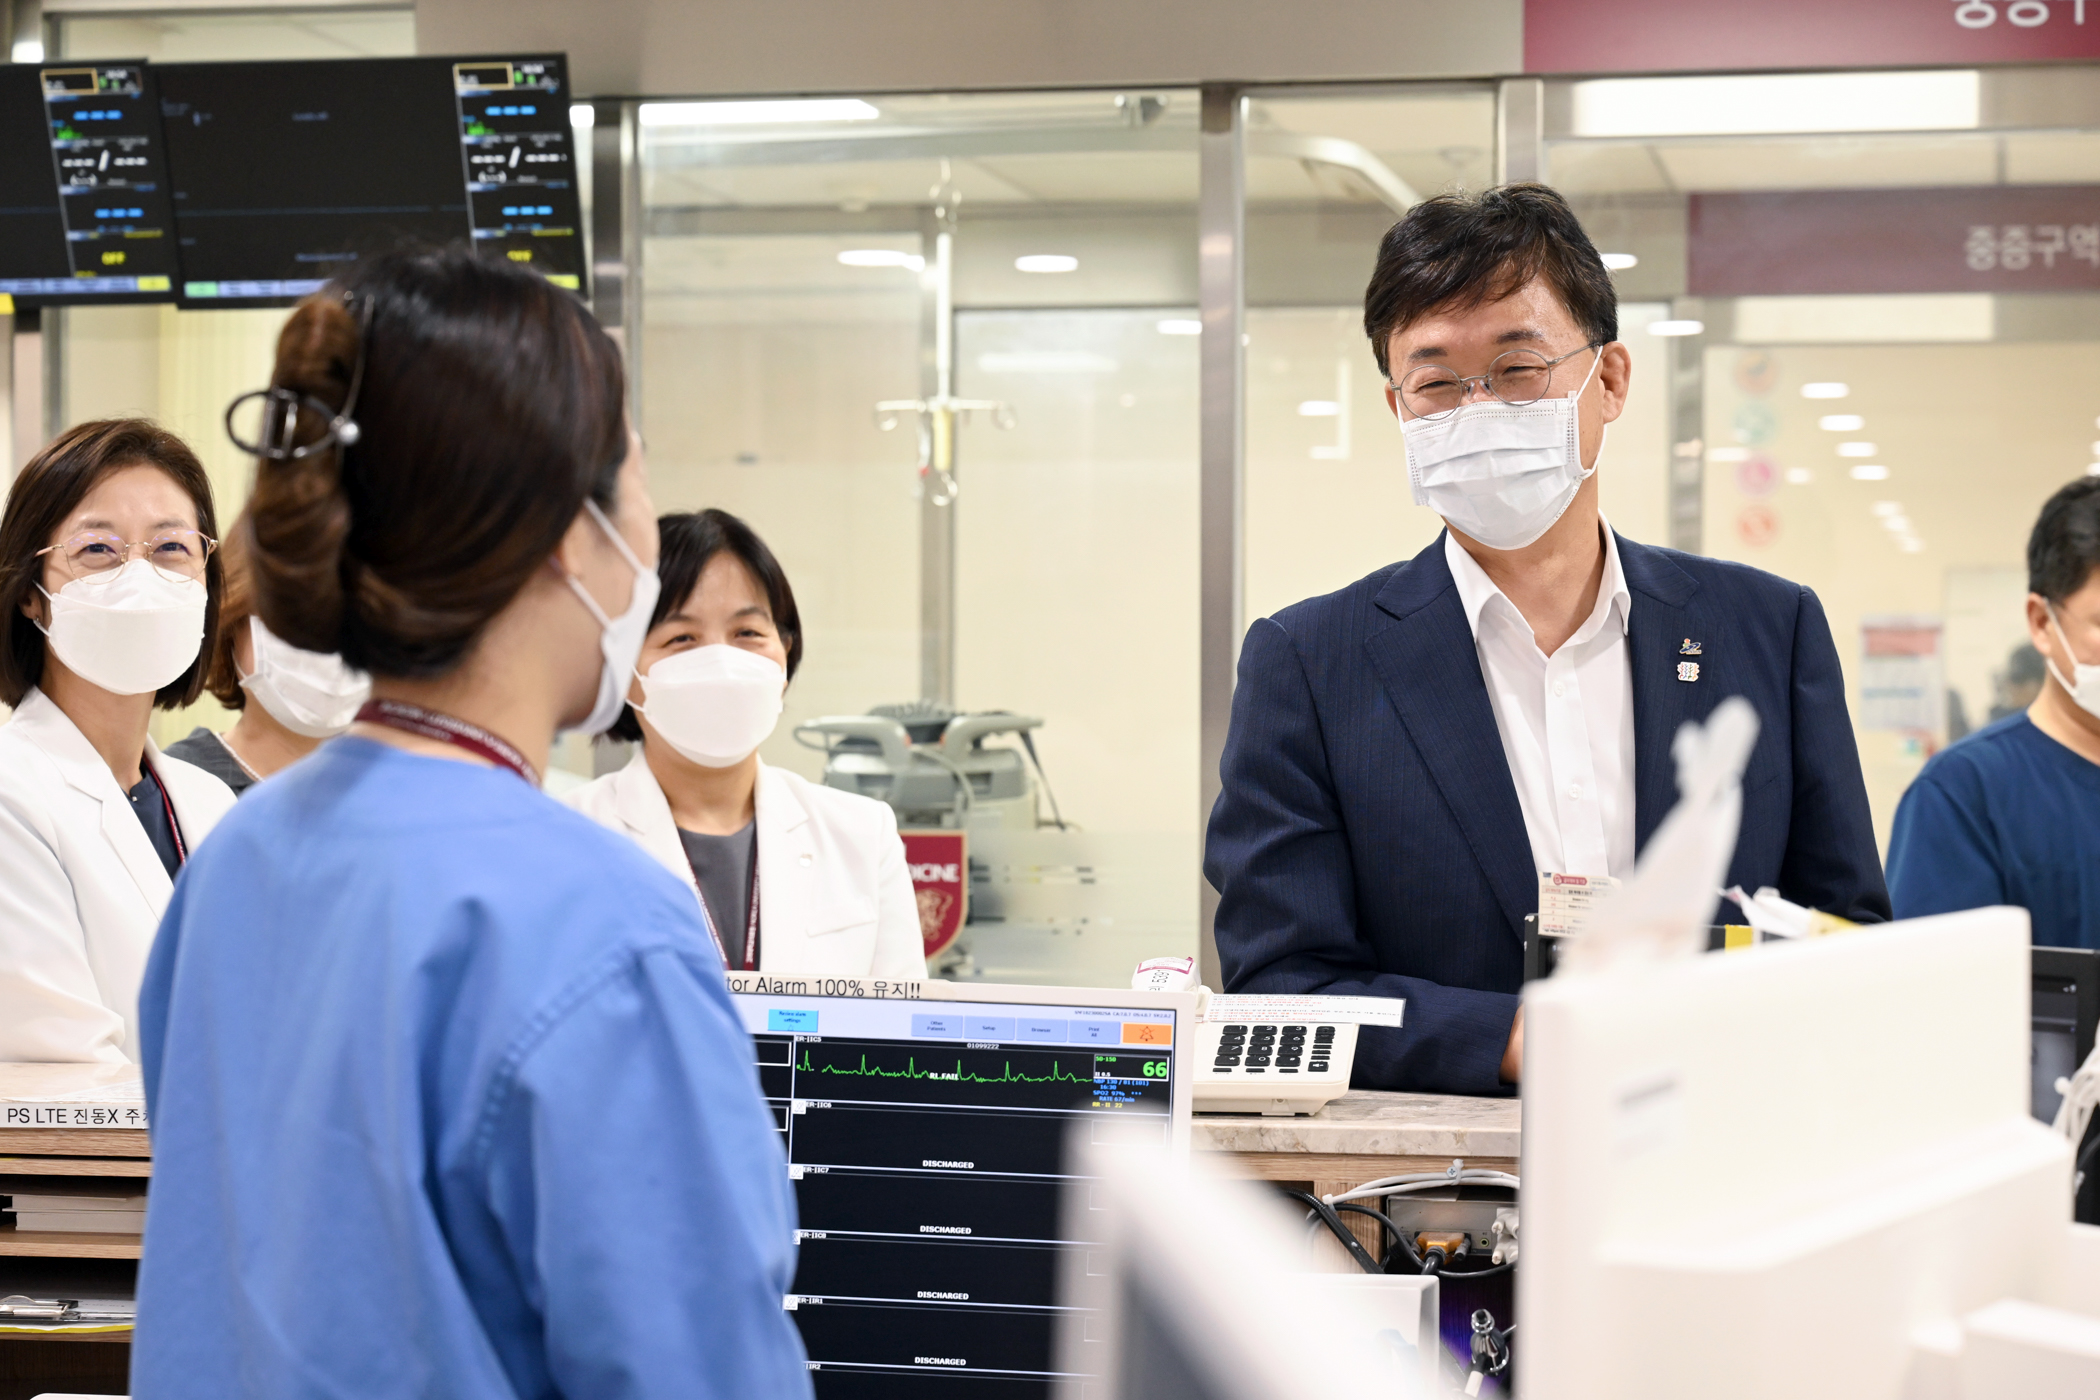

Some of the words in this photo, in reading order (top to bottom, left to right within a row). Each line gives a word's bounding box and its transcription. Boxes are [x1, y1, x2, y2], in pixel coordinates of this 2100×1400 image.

[755, 976, 807, 995] Alarm
[815, 978, 865, 997] 100%
[872, 980, 921, 998] 유지!!
[1142, 1060, 1168, 1078] 66
[941, 1072, 959, 1080] FAIL
[7, 1107, 31, 1124] PS
[35, 1108, 68, 1124] LTE
[73, 1108, 119, 1125] 진동X
[922, 1159, 975, 1169] DISCHARGED
[919, 1225, 972, 1235] DISCHARGED
[917, 1290, 970, 1300] DISCHARGED
[914, 1356, 967, 1366] DISCHARGED
